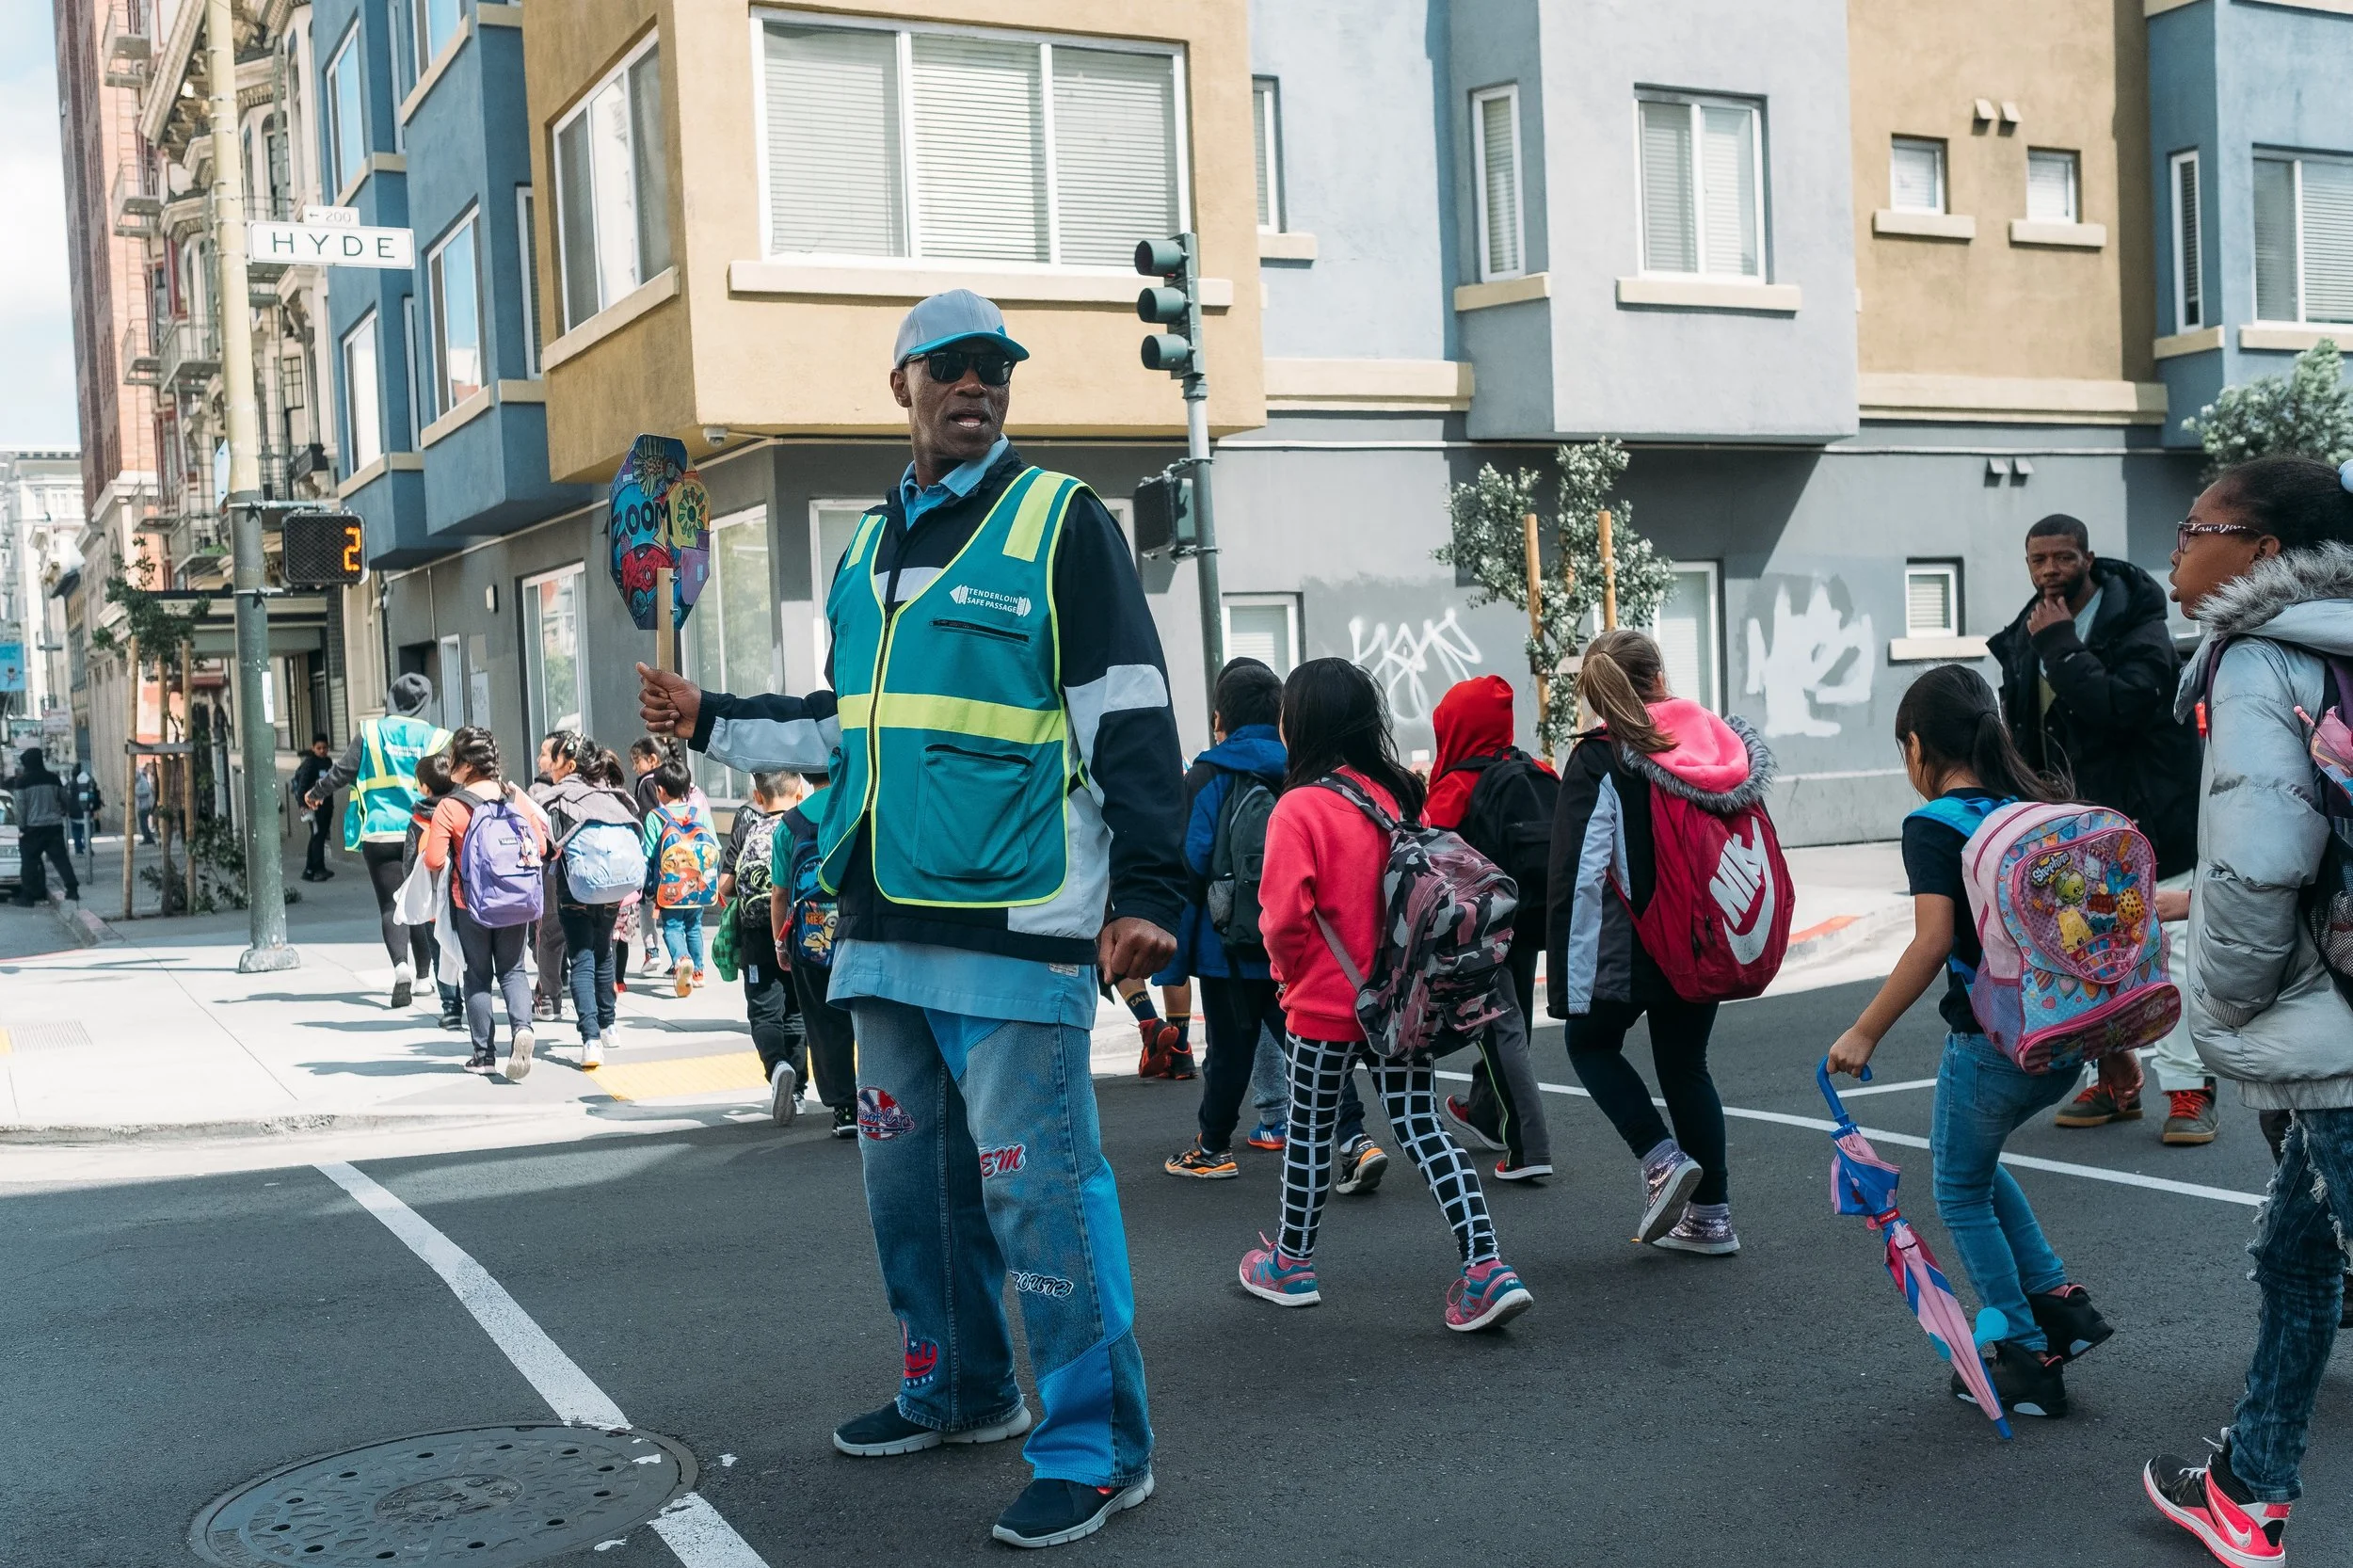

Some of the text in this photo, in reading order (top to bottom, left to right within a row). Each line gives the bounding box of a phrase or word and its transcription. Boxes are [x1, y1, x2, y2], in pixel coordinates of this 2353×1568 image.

[325, 211, 351, 223] 200
[272, 232, 395, 259] HYDE
[613, 500, 674, 549] ZOOM
[344, 527, 361, 571] 2
[967, 597, 1017, 614] SAFE PASSAGE
[968, 587, 1018, 604] TENDERLOIN
[2032, 852, 2070, 883] Shopkins
